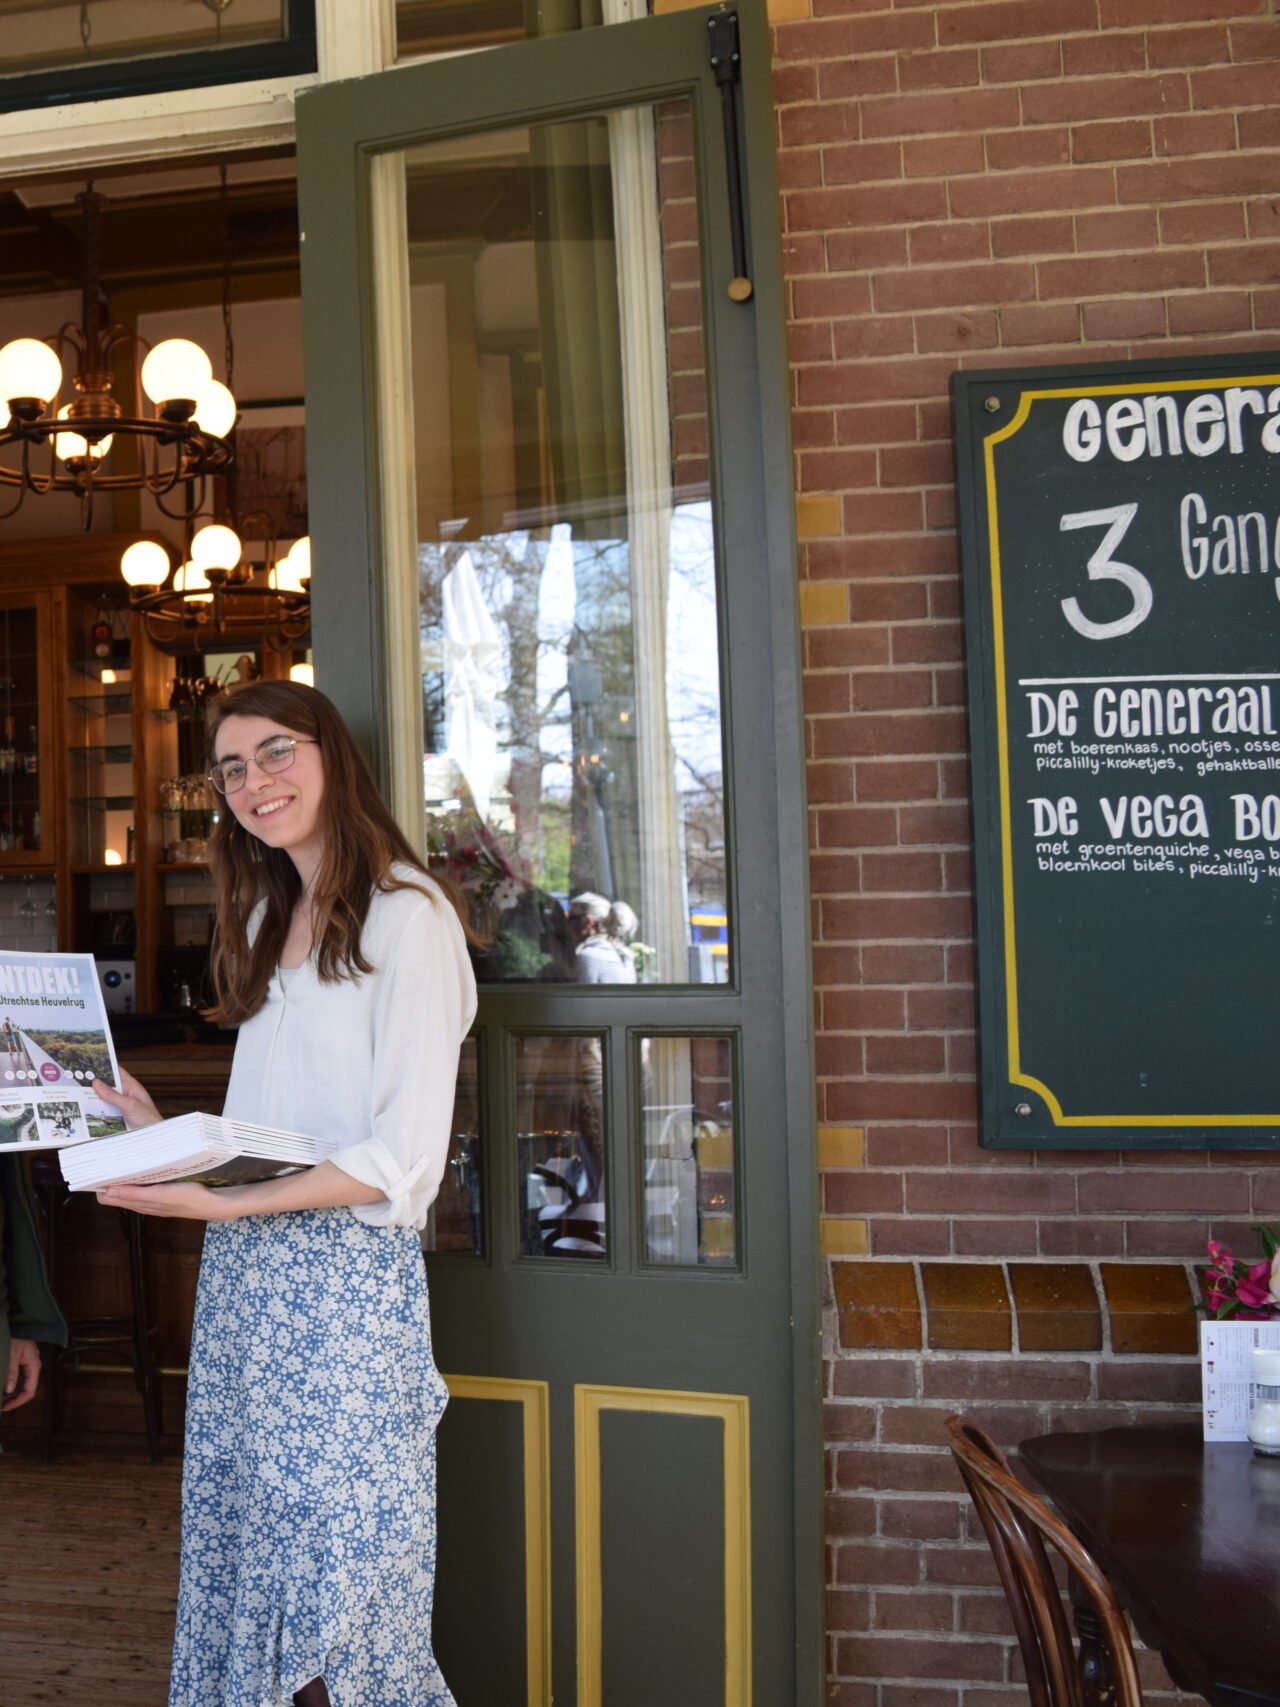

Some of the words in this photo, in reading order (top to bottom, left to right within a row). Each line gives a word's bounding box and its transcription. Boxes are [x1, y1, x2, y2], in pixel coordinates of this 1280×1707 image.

[1059, 502, 1154, 641] 3
[1180, 492, 1280, 601] Gan
[1033, 739, 1064, 755] met
[1168, 739, 1240, 759] nootjes,
[1035, 839, 1070, 856] met
[1223, 847, 1266, 865] vega
[1037, 855, 1126, 872] bloemkool
[1189, 860, 1280, 884] piccalilly-k
[40, 995, 86, 1010] Heuvelrug
